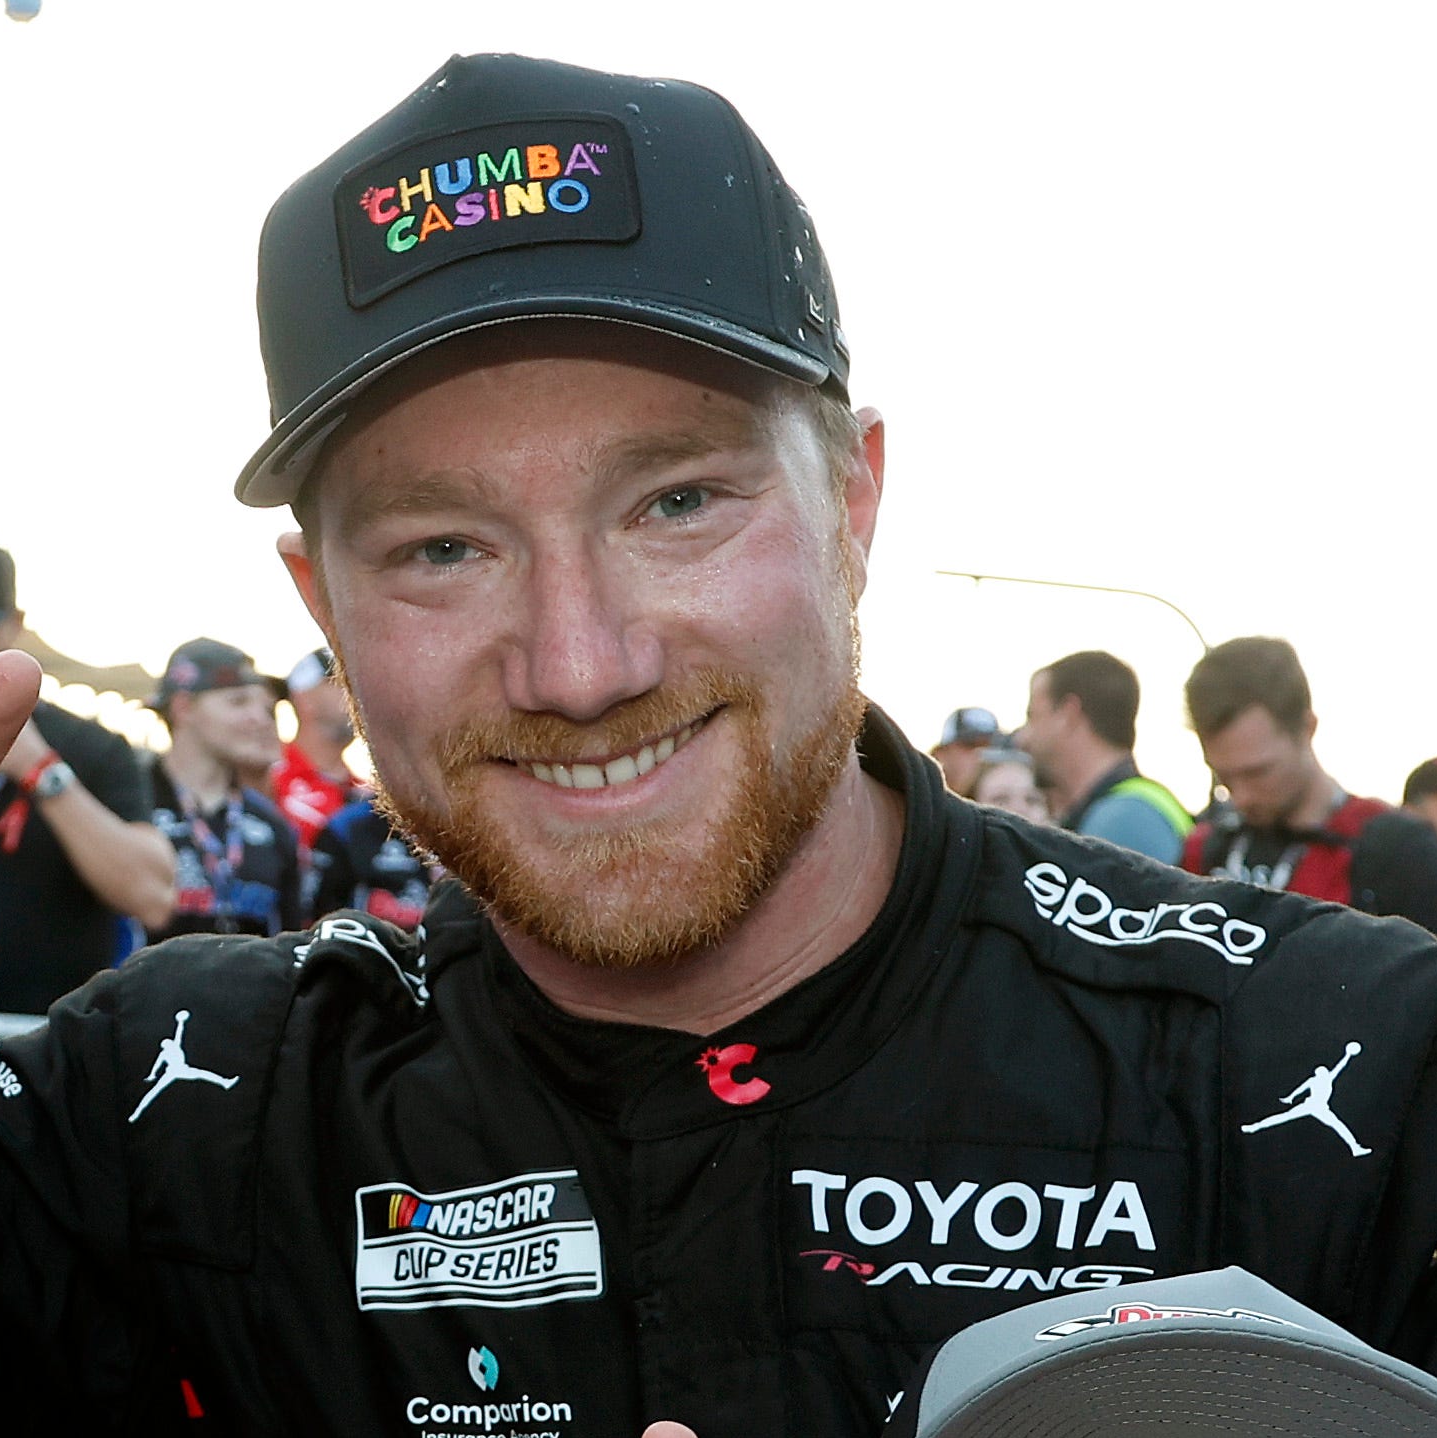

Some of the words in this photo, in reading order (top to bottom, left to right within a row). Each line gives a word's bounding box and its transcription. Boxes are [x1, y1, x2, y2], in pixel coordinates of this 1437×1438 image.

[359, 143, 602, 224] CHUMBA
[386, 178, 591, 253] CASINO
[1024, 862, 1266, 965] sparco
[426, 1184, 556, 1236] NASCAR
[792, 1169, 1157, 1251] TOYOTA
[394, 1246, 447, 1281] CUP
[450, 1238, 560, 1281] SERIES
[406, 1395, 572, 1431] Comparion
